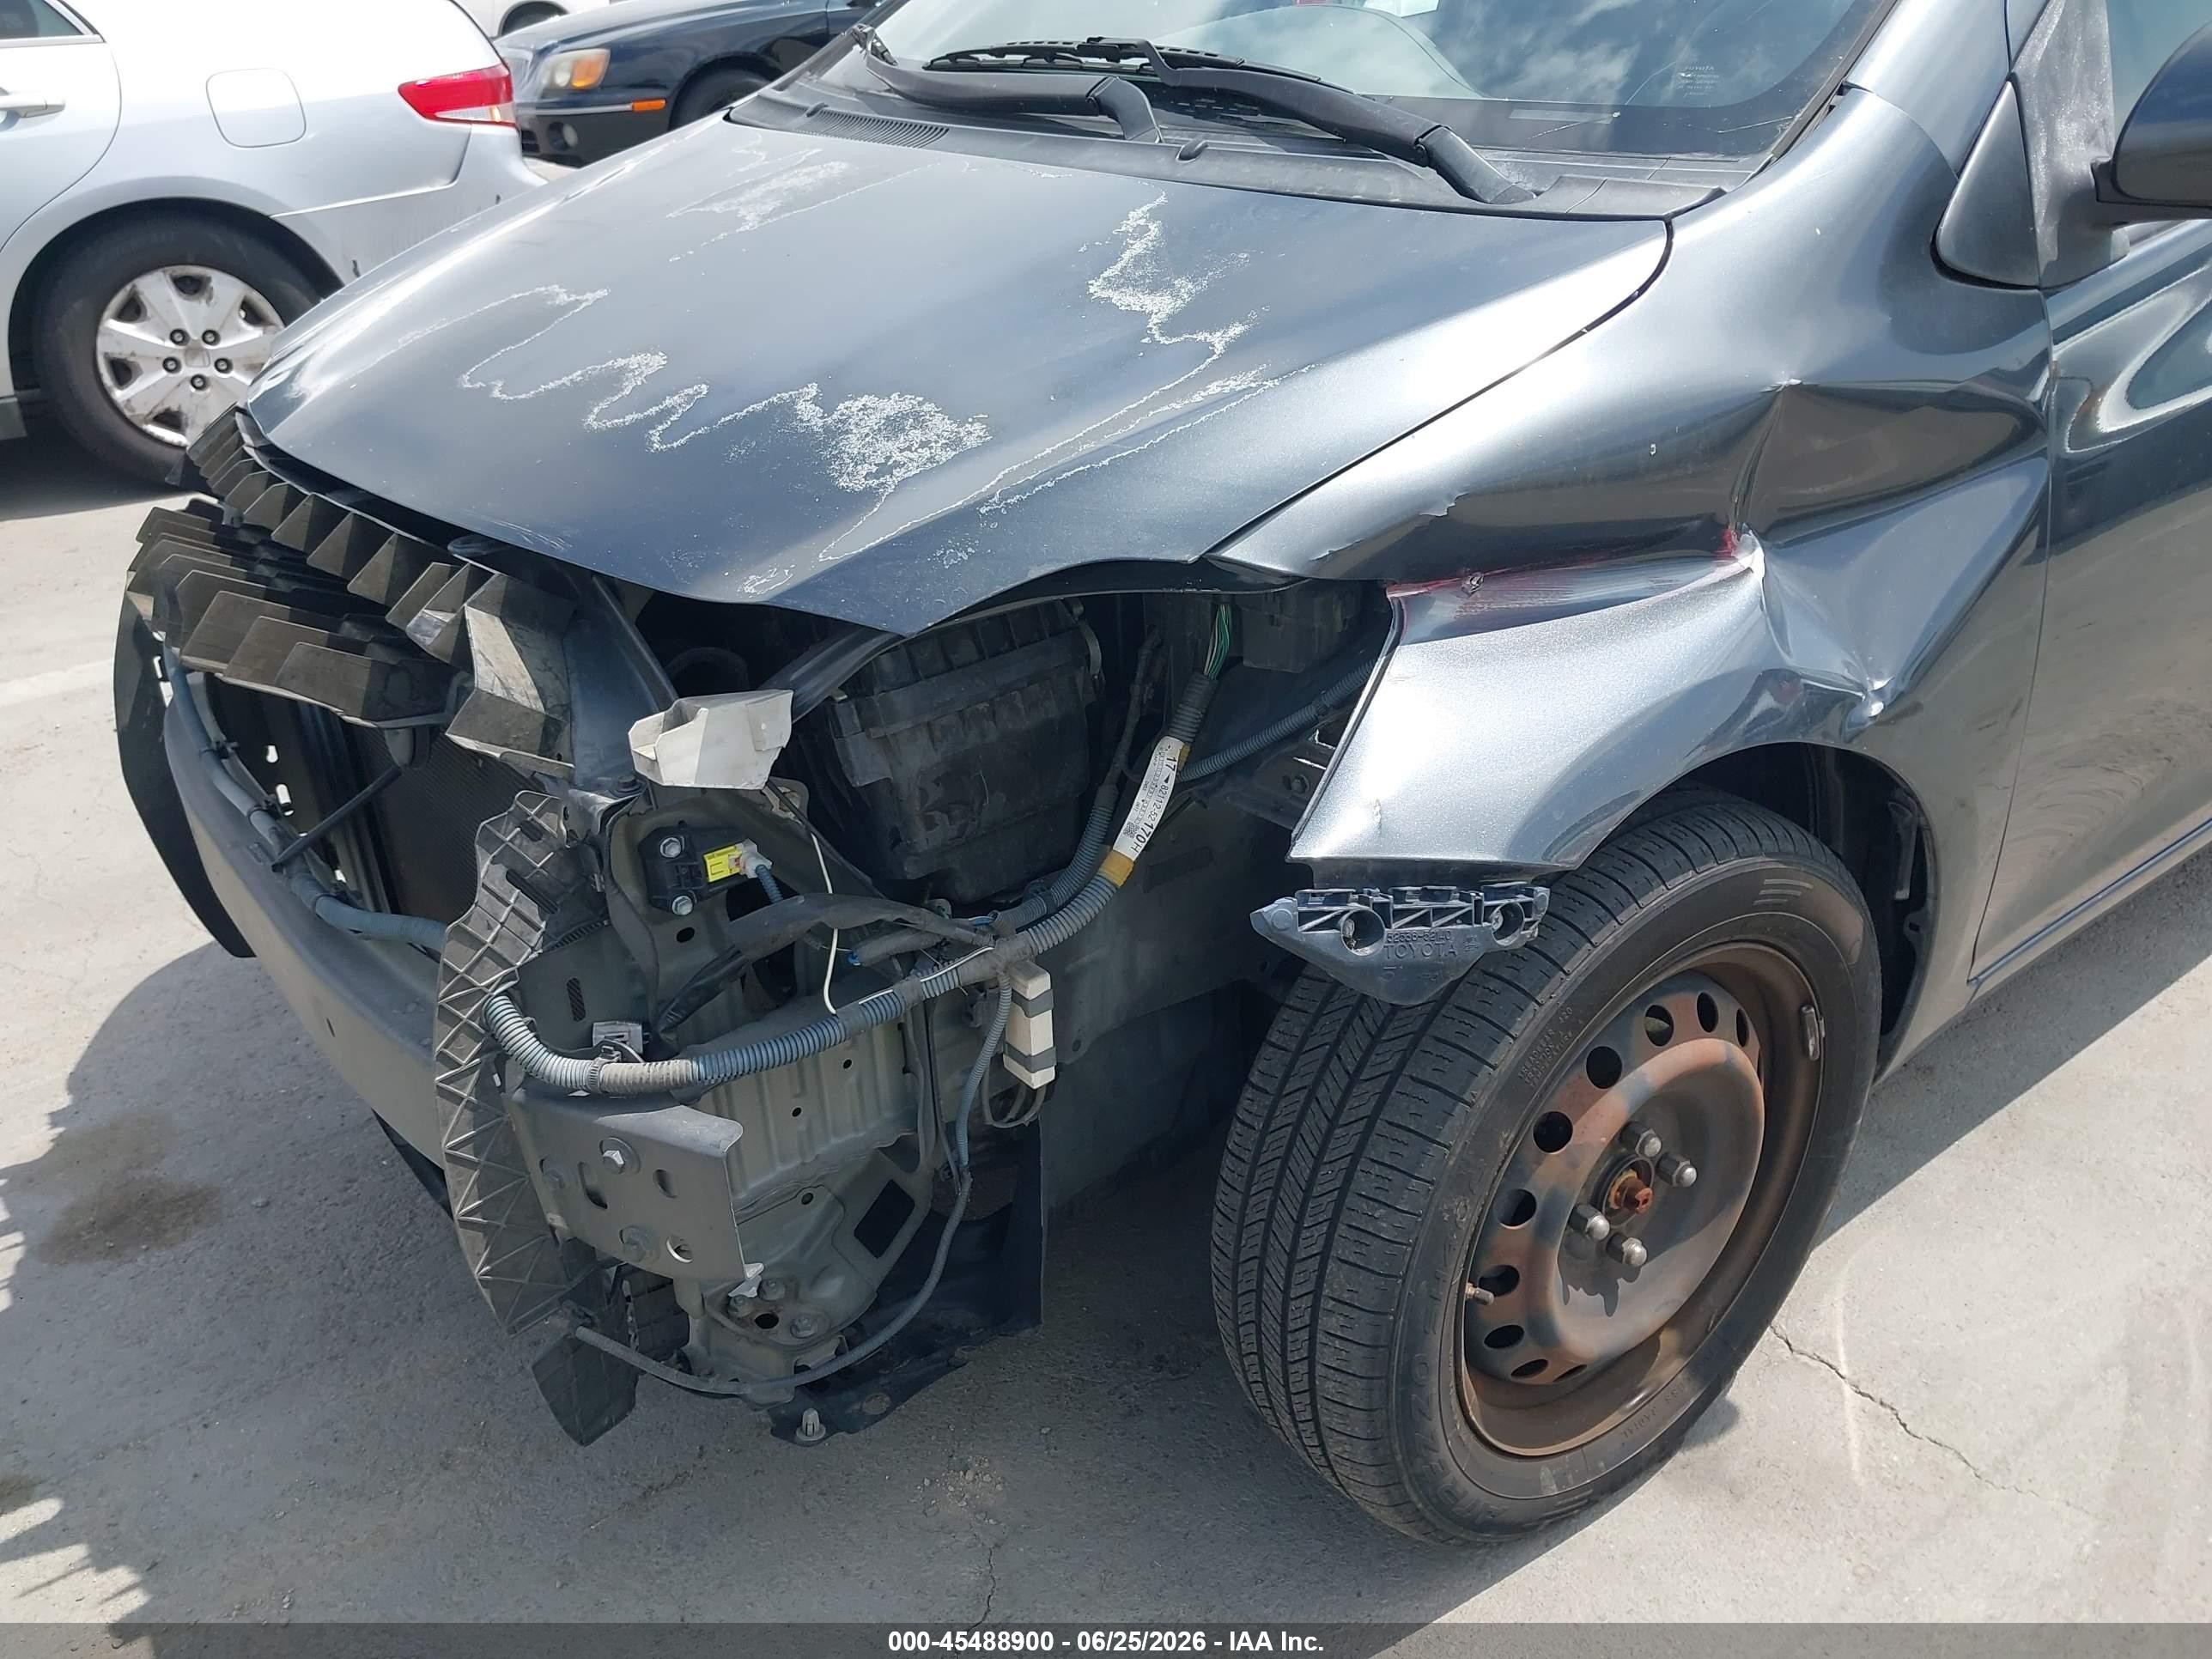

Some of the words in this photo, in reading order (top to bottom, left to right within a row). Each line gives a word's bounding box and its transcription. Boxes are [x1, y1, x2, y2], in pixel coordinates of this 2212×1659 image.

[1166, 757, 1177, 772] 17
[1130, 783, 1170, 853] 82112-52170H
[1383, 942, 1458, 959] TOYOTA
